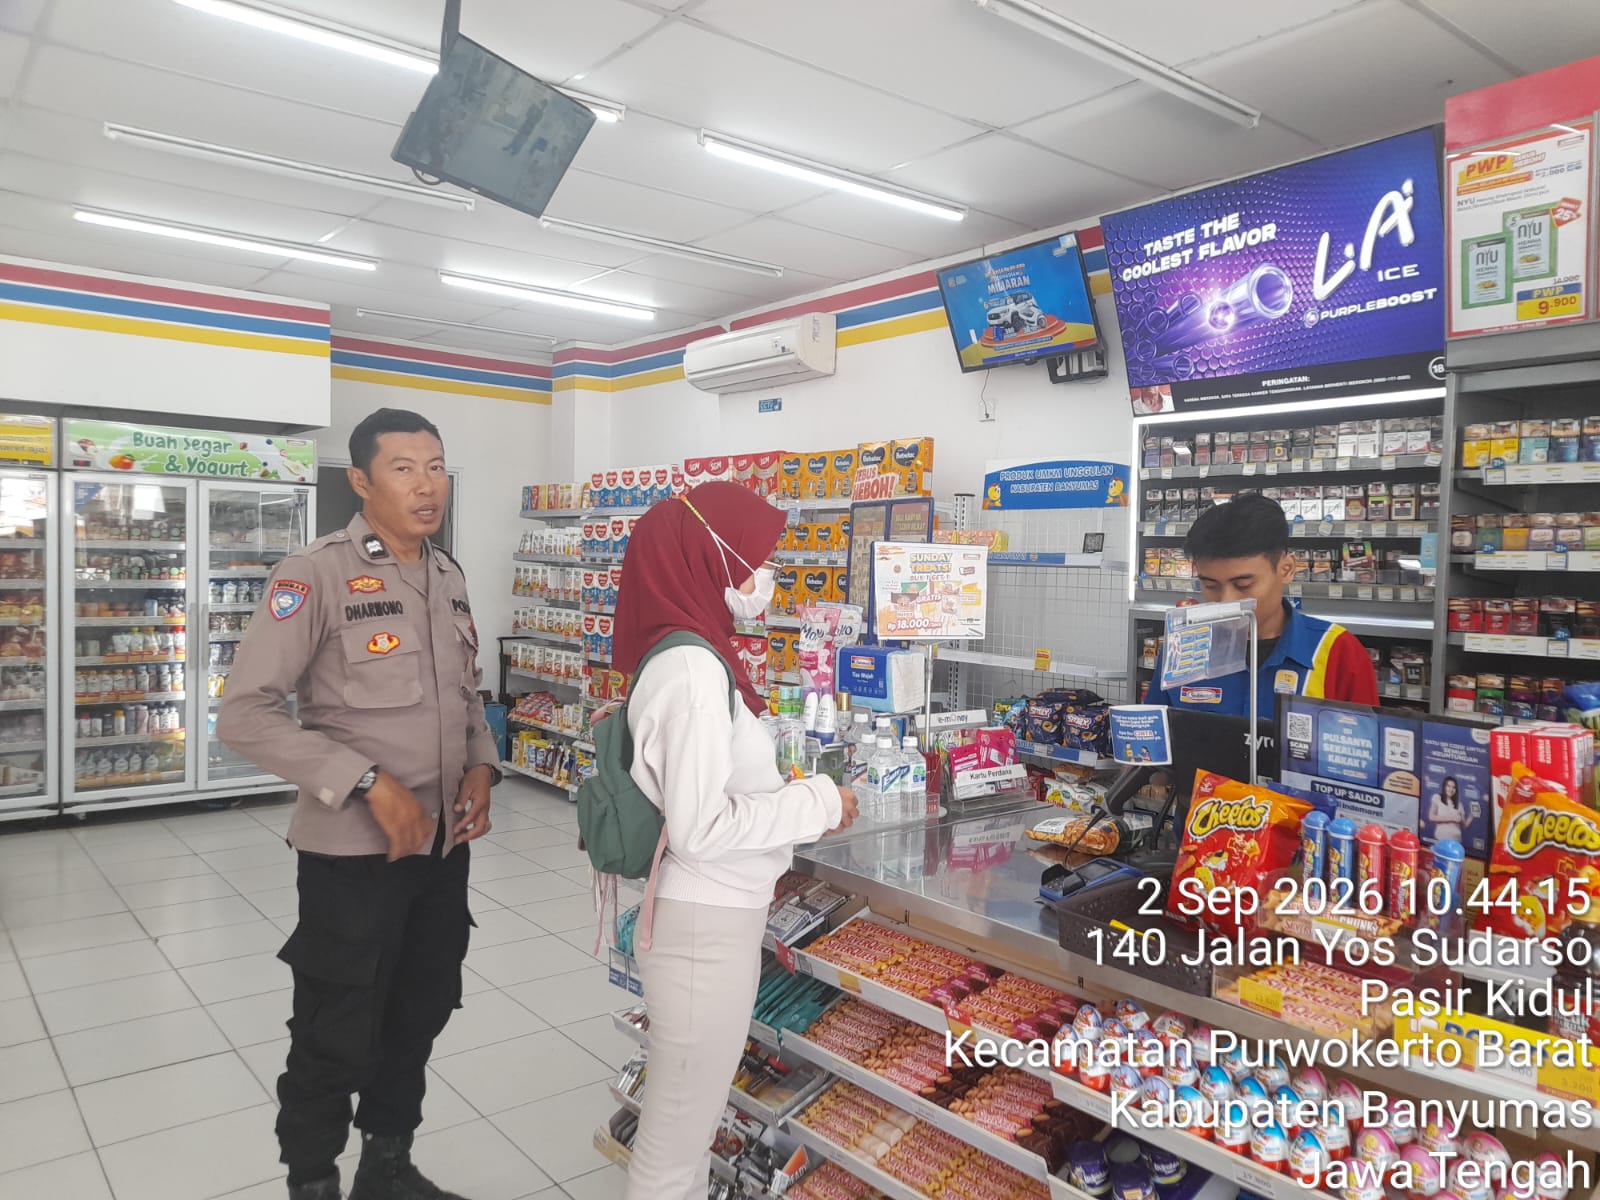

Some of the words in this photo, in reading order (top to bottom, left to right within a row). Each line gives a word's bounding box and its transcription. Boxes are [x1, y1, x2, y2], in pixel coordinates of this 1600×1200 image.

[1465, 154, 1509, 177] PWP
[1143, 226, 1195, 258] TASTE
[1199, 213, 1241, 239] THE
[1122, 249, 1194, 283] COOLEST
[1198, 222, 1277, 262] FLAVOR
[1377, 264, 1420, 282] ICE
[1533, 286, 1564, 299] PWP
[1320, 288, 1438, 321] PURPLEBOOST
[1538, 296, 1577, 315] 9.900
[1262, 375, 1311, 387] PERINGATAN:
[183, 437, 233, 458] Segar
[165, 455, 181, 473] &
[186, 456, 249, 477] Yogurt
[1000, 470, 1034, 482] PRODUK
[1064, 465, 1114, 479] UNGGULAN
[1010, 482, 1053, 494] KABUPATEN
[1055, 480, 1100, 492] BANYUMAS
[910, 553, 954, 562] SUNDAY
[897, 618, 930, 630] 18.000
[1290, 741, 1309, 750] SCAN
[1322, 733, 1373, 749] PULSANYA
[1322, 743, 1373, 760] SEKALIAN,
[970, 771, 987, 780] Kartu
[987, 769, 1013, 777] Perdana
[1314, 783, 1334, 795] TOP
[1334, 788, 1347, 797] UP
[1348, 791, 1381, 805] SALDO
[1190, 796, 1269, 838] Cheetos
